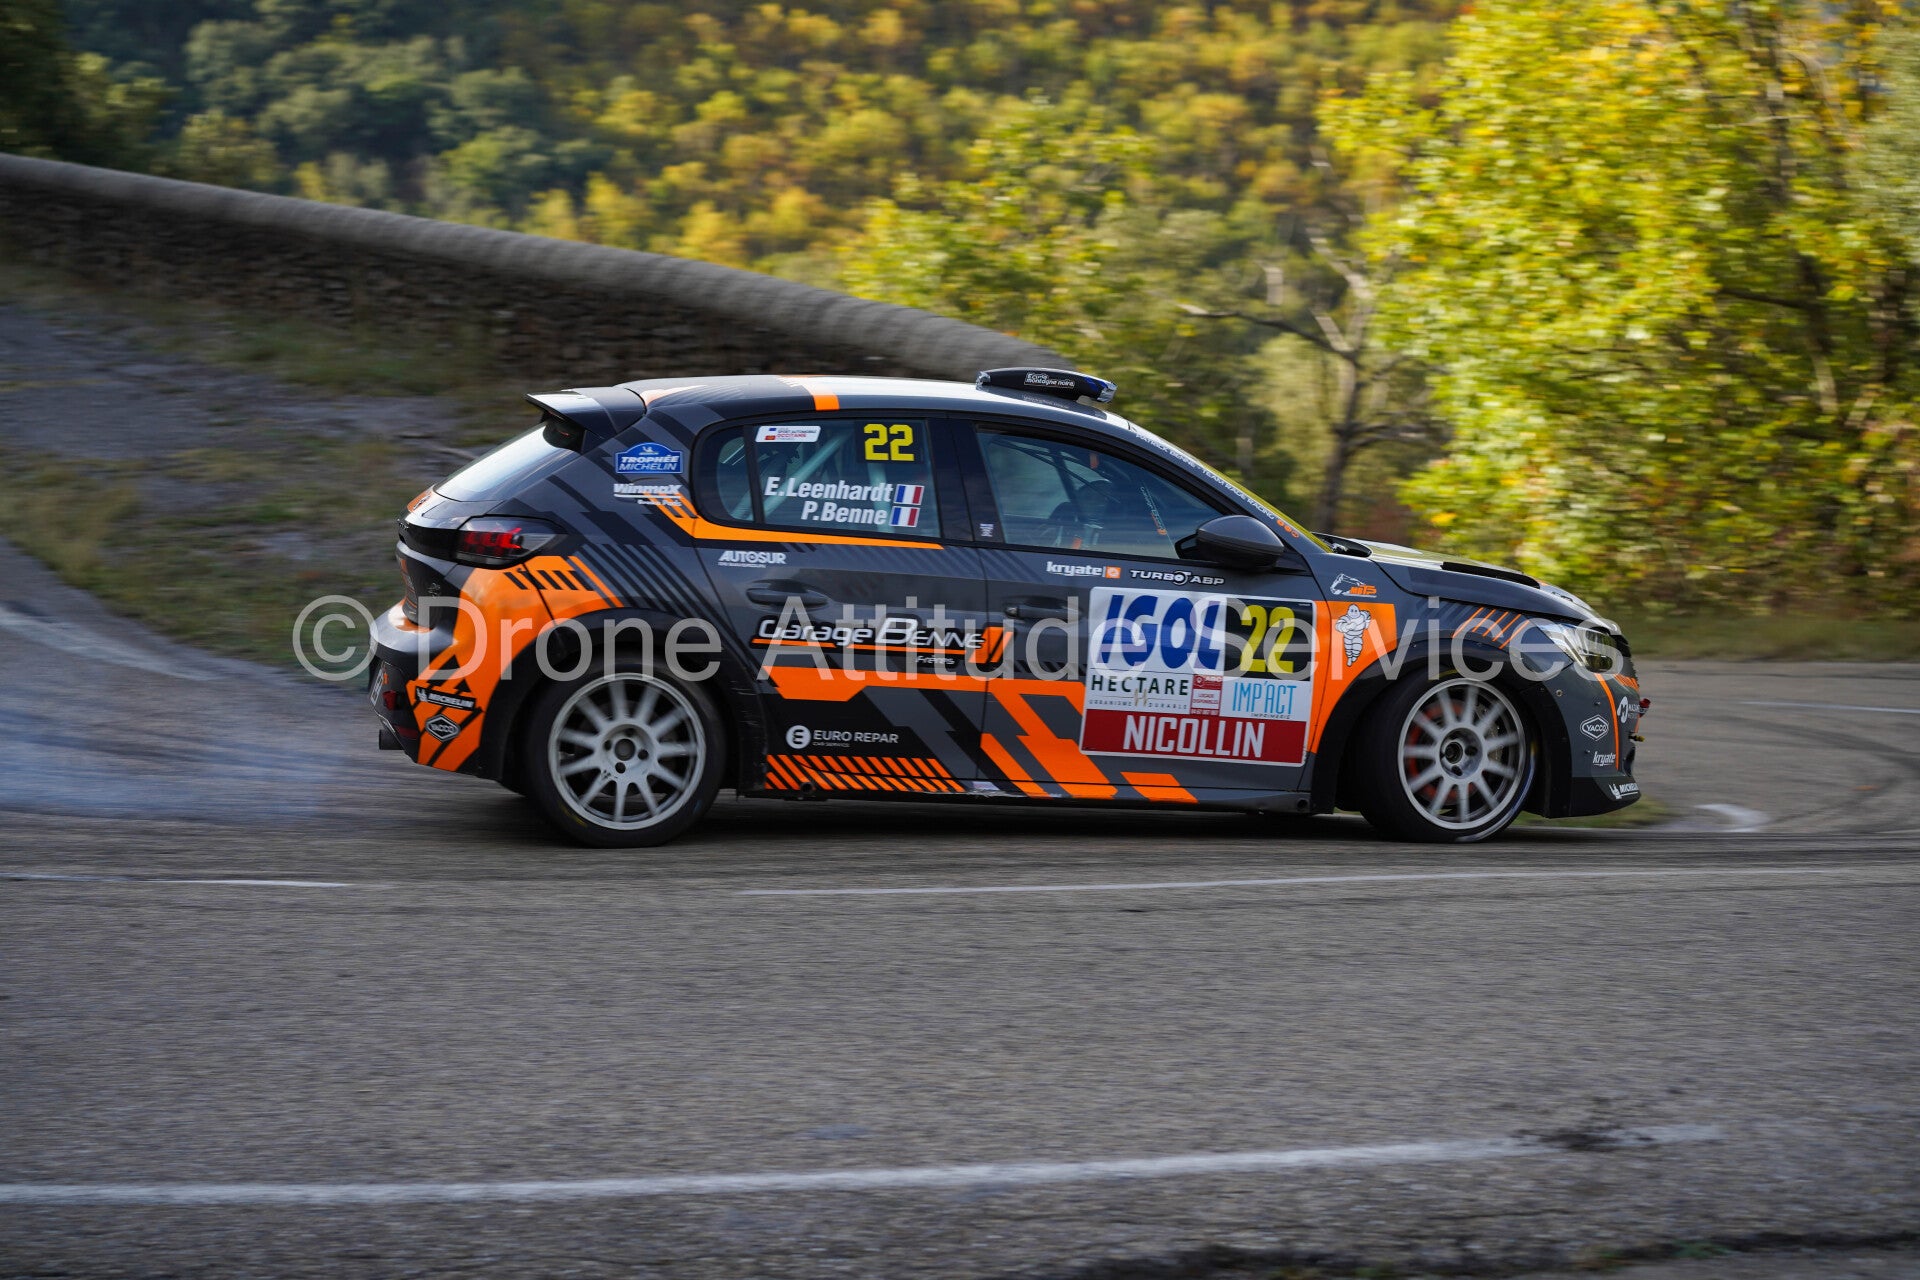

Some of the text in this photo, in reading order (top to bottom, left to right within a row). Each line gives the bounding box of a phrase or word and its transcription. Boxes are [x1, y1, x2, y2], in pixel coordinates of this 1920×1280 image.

[863, 423, 915, 462] 22
[619, 462, 677, 471] MICHELIN
[621, 454, 680, 463] TROPHÉE
[764, 476, 893, 502] E.Leenhardt
[1202, 469, 1224, 486] TEAM
[1247, 498, 1275, 520] RACING
[800, 500, 888, 525] P.Benne
[718, 550, 787, 565] AUTOSUR
[1046, 561, 1103, 577] kryate
[758, 618, 873, 647] Garage
[1096, 594, 1226, 669] IGOL
[1240, 605, 1295, 674] 22
[1091, 675, 1189, 695] HECTARE
[813, 729, 899, 743] EURO REPAR
[1123, 715, 1266, 758] NICOLLIN
[1586, 723, 1607, 732] YACCO
[1593, 751, 1617, 767] kryate
